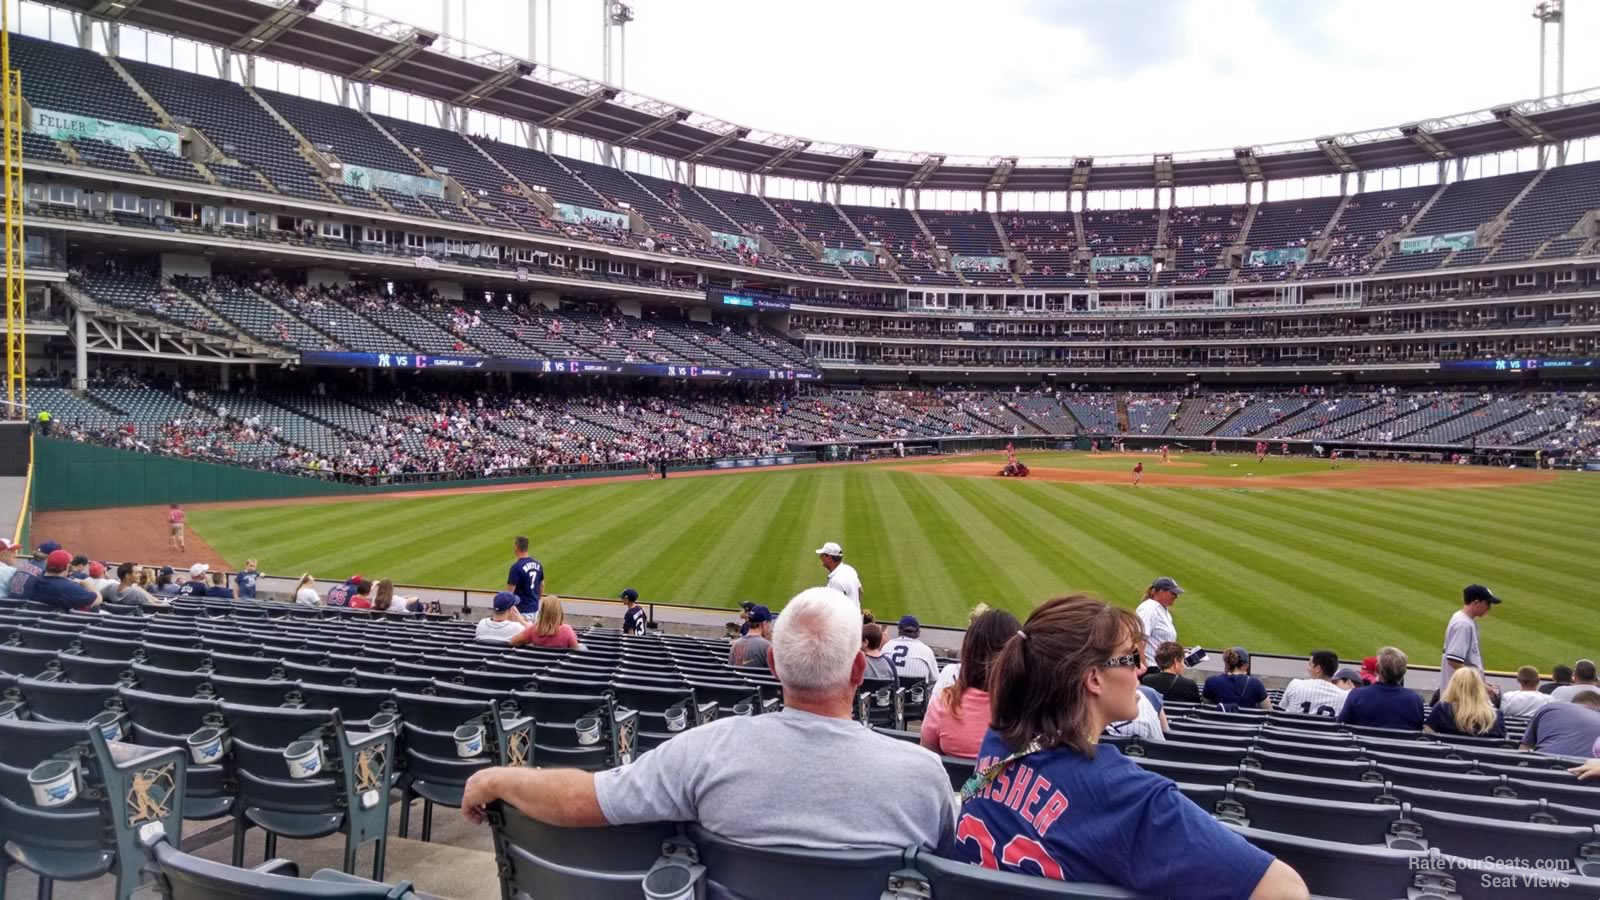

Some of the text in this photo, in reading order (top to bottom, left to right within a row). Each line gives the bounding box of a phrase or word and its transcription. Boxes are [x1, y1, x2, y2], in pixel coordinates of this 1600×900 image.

[39, 114, 86, 132] FELLER
[396, 356, 408, 366] VS
[416, 355, 426, 368] C
[555, 362, 565, 371] VS
[1527, 360, 1536, 368] C
[679, 367, 686, 375] VS
[529, 571, 537, 589] 7
[892, 645, 909, 667] 2
